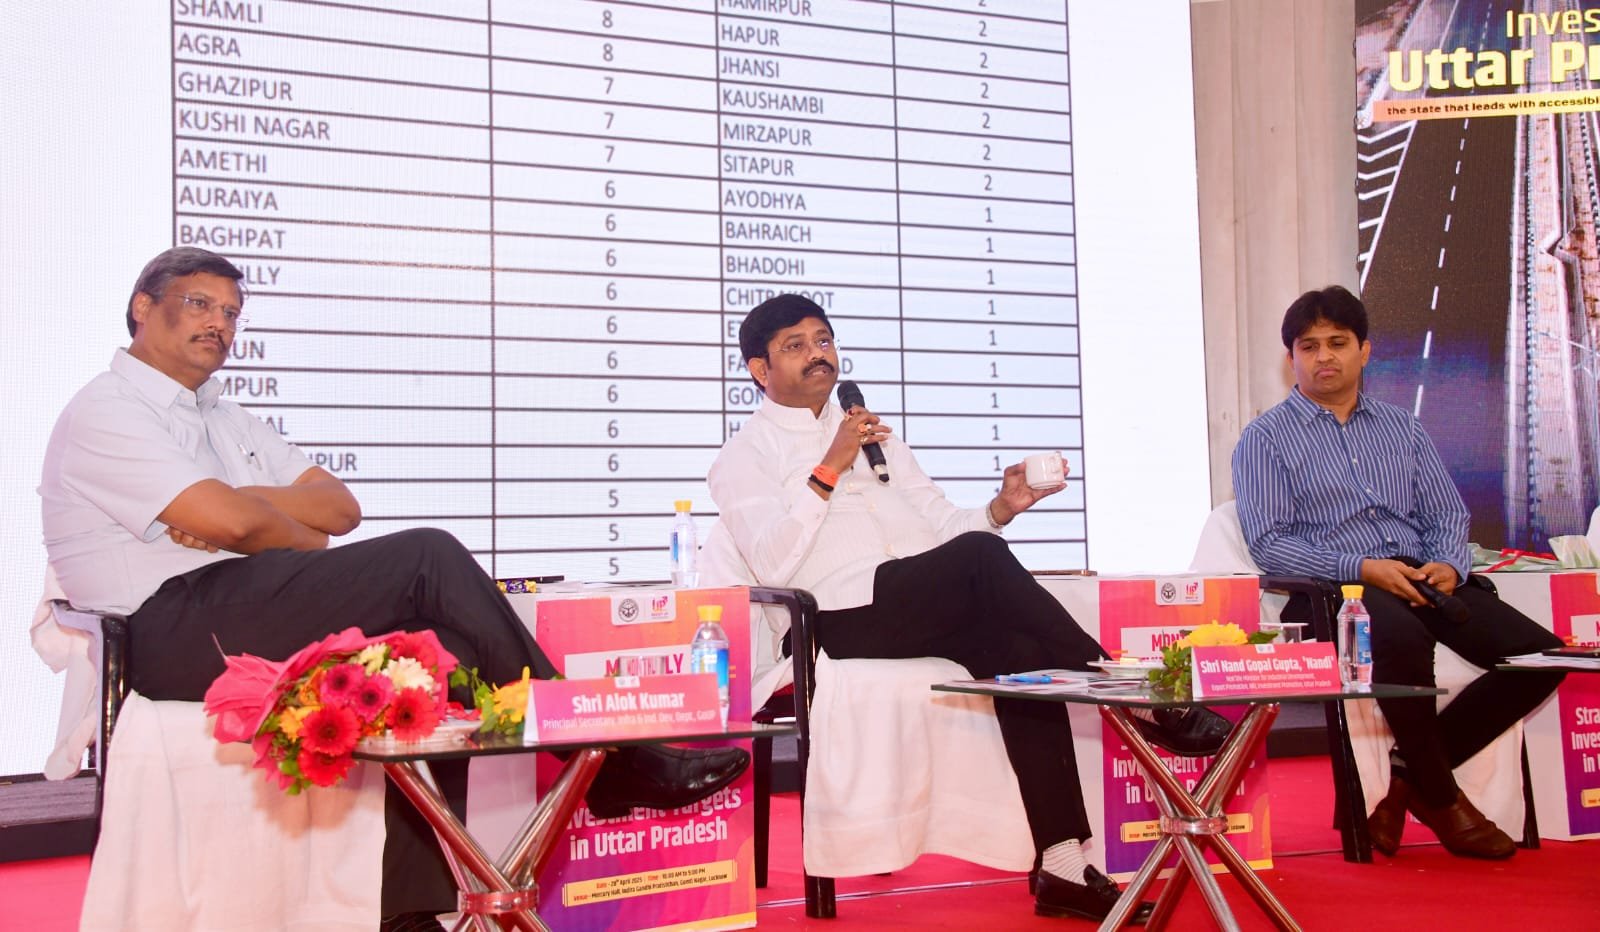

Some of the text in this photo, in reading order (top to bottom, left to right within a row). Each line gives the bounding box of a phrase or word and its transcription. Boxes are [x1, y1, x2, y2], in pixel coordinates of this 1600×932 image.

[177, 0, 263, 23] SHAMLI
[721, 0, 811, 17] HAMIRPUR
[602, 9, 614, 29] 8
[1506, 9, 1600, 38] Inves
[721, 24, 779, 46] HAPUR
[978, 20, 987, 38] 2
[178, 33, 241, 57] AGRA
[602, 42, 614, 62] 8
[721, 57, 780, 78] JHANSI
[979, 51, 989, 69] 2
[1389, 47, 1535, 92] Uttar
[178, 72, 293, 100] GHAZIPUR
[604, 76, 614, 95] 7
[980, 82, 989, 99] 2
[723, 89, 824, 114] KAUSHAMBI
[1387, 107, 1407, 115] the
[1409, 105, 1442, 114] state
[1444, 103, 1469, 112] that
[1472, 102, 1505, 111] leads
[1509, 100, 1536, 109] with
[179, 110, 330, 140] KUSHI NAGAR
[604, 111, 615, 129] 7
[982, 112, 991, 130] 2
[724, 122, 812, 146] MIRZAPUR
[179, 149, 267, 173] AMETHI
[605, 145, 615, 163] 7
[983, 143, 991, 161] 2
[724, 155, 794, 176] SITAPUR
[604, 180, 616, 199] 6
[984, 174, 992, 192] 2
[179, 186, 278, 210] AURAIYA
[725, 189, 807, 211] AYODHYA
[605, 213, 617, 232] 6
[985, 206, 993, 223] 1
[180, 226, 285, 249] BAGHPAT
[726, 222, 812, 243] BAHRAICH
[986, 237, 994, 254] 1
[605, 248, 617, 268] 6
[726, 256, 805, 275] BHADOHI
[987, 268, 995, 286] 1
[606, 282, 618, 301] 6
[988, 299, 996, 316] 1
[606, 315, 618, 335] 6
[989, 329, 997, 346] 1
[606, 350, 618, 370] 6
[991, 361, 999, 379] 1
[221, 377, 278, 397] MPUR
[607, 384, 619, 404] 6
[991, 392, 999, 409] 1
[607, 419, 619, 439] 6
[992, 424, 1000, 441] 1
[607, 453, 619, 473] 6
[993, 455, 1002, 472] 1
[608, 489, 619, 508] 5
[608, 523, 620, 542] 5
[609, 557, 620, 576] 5
[1200, 660, 1220, 673] Shri
[1221, 659, 1245, 672] Nand
[1246, 658, 1272, 673] Gopal
[1273, 658, 1302, 672] Gupta,
[572, 692, 685, 713] Shri Alok Kumar
[543, 716, 577, 729] Principal
[1583, 753, 1596, 773] in
[1126, 782, 1141, 804] in
[570, 835, 589, 861] in
[595, 830, 645, 857] Uttar
[651, 816, 728, 850] Pradesh
